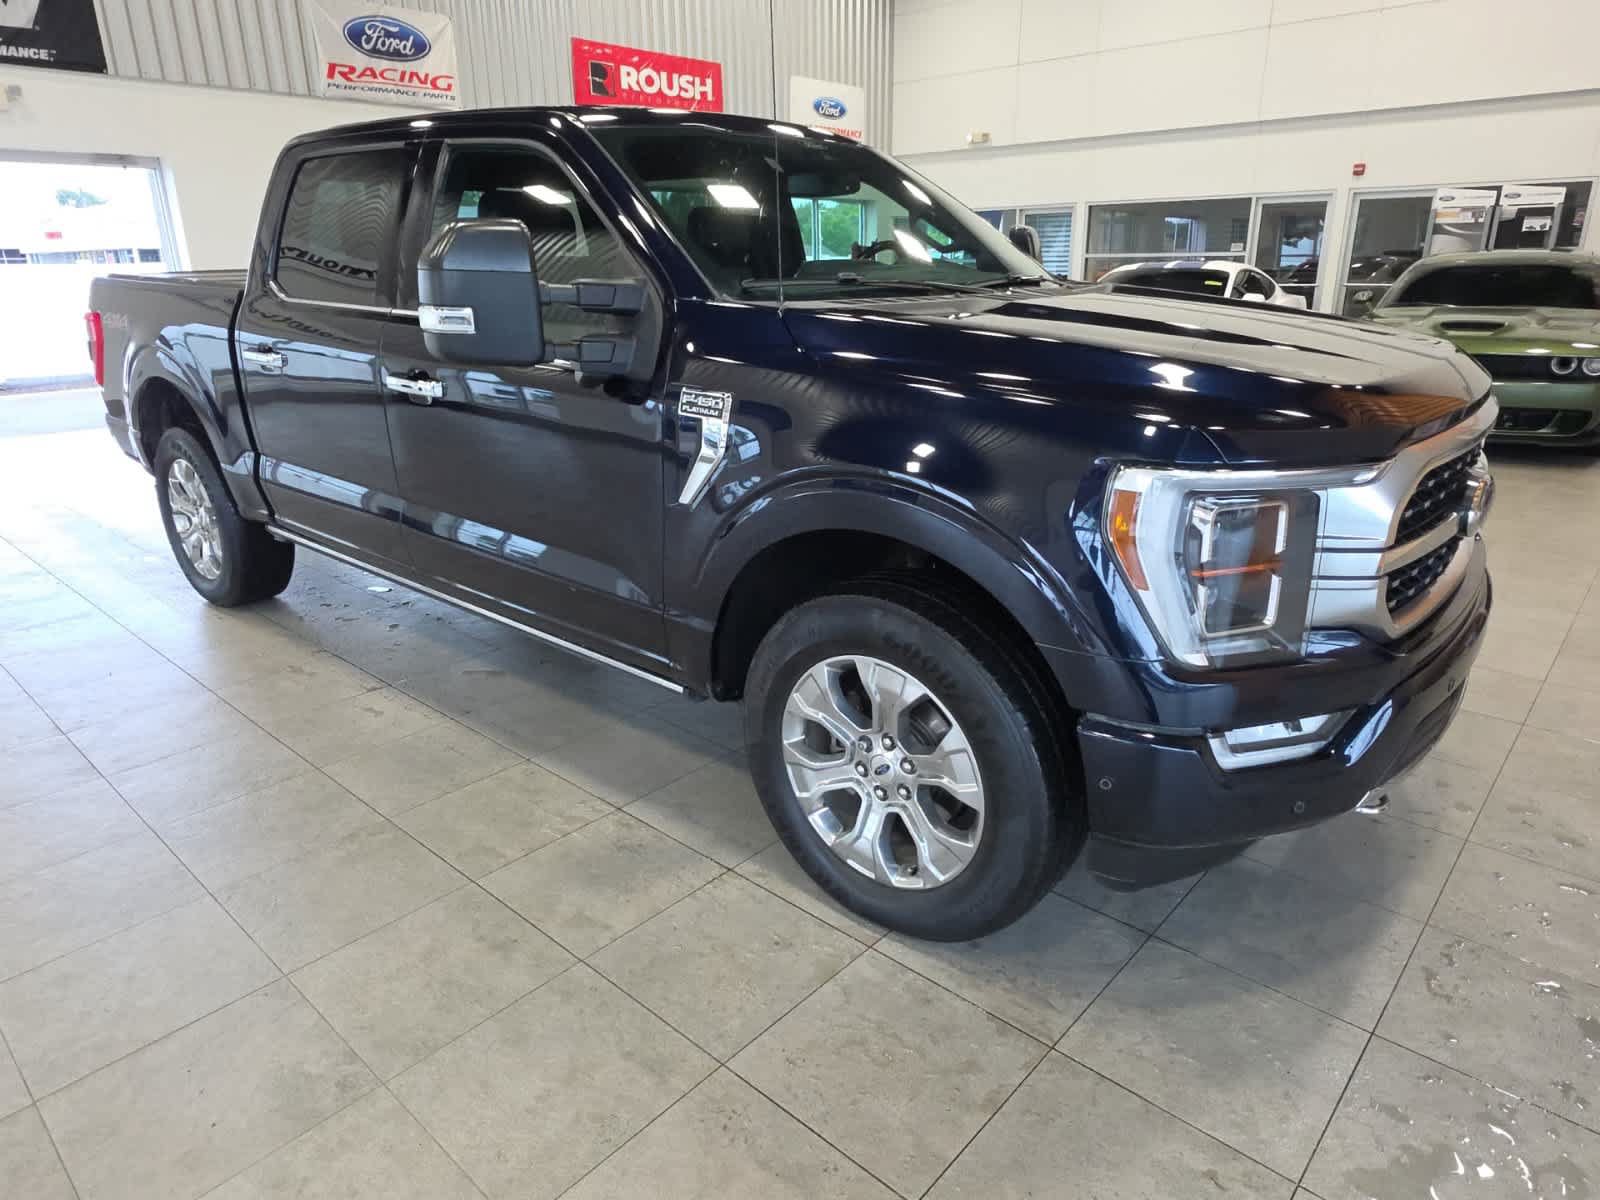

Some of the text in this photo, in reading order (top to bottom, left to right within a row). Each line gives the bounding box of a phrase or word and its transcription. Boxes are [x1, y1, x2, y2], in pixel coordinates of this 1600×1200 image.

[361, 22, 415, 55] Ford
[327, 63, 454, 91] RACING
[619, 64, 713, 101] ROUSH
[327, 83, 456, 101] PERFORMANCE PARTS
[818, 97, 841, 117] Ford
[682, 405, 718, 416] PLATINUM
